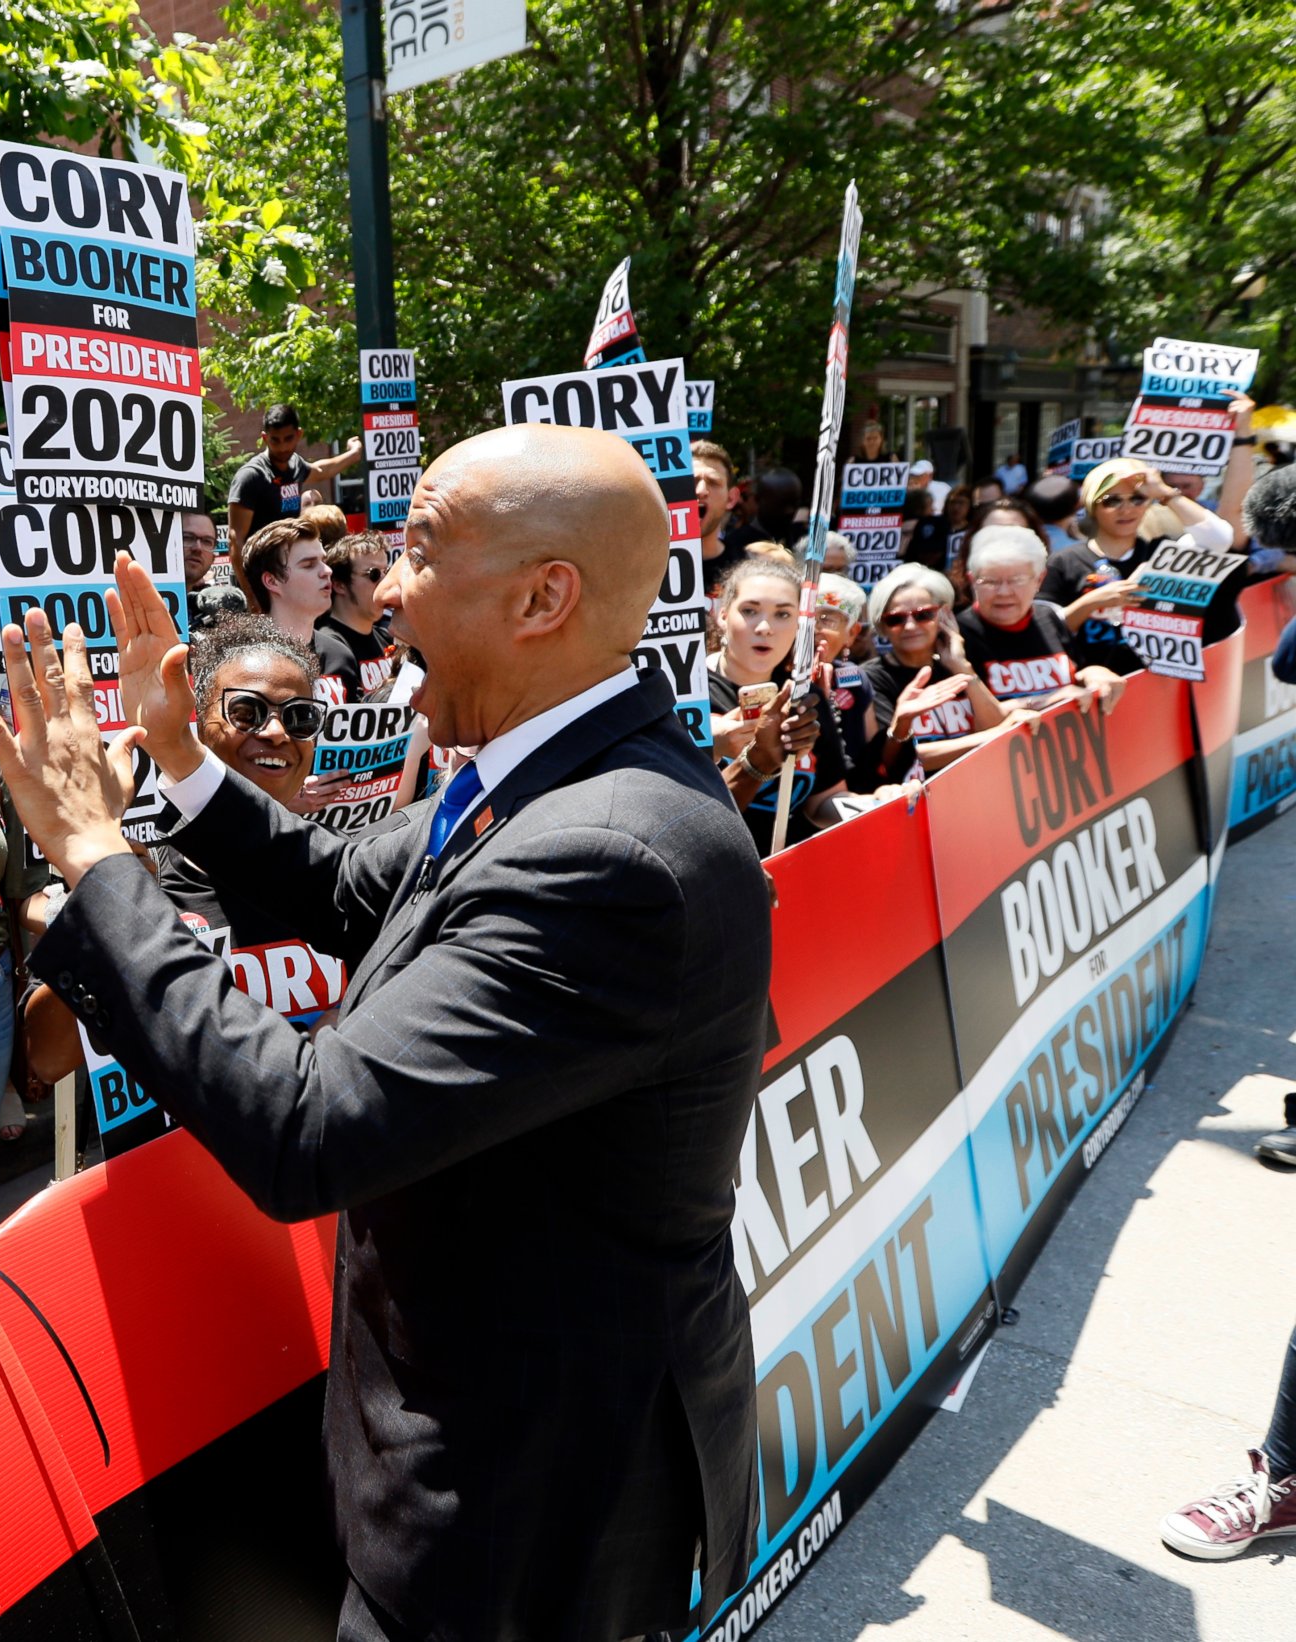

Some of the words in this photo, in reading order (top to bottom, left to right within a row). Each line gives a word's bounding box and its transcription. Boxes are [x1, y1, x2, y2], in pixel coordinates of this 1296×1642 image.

[0, 151, 183, 245] CORY
[10, 235, 190, 308] BOOKER
[92, 303, 131, 330] FOR
[21, 331, 193, 387] PRESIDENT
[368, 354, 411, 379] CORY
[1151, 351, 1242, 377] CORY
[370, 382, 412, 400] BOOKER
[510, 366, 679, 430] CORY
[21, 384, 196, 472] 2020
[372, 413, 413, 428] PRESIDENT
[688, 412, 709, 429] ER
[373, 430, 415, 457] 2020
[632, 435, 688, 474] ER
[1076, 441, 1123, 460] COR
[1129, 429, 1226, 460] 2020
[24, 475, 198, 508] CORYBOOKER.COM
[376, 471, 418, 498] CORY
[848, 466, 908, 488] CORY
[378, 502, 412, 519] BOOK
[846, 490, 903, 504] BOOKER
[841, 515, 901, 529] PRESIDENT
[1151, 545, 1240, 579] CORY
[1125, 610, 1201, 635] PRESIDENT
[1127, 631, 1198, 667] 2020
[988, 654, 1071, 694] CORY
[323, 707, 416, 742] CORY
[319, 738, 408, 771] BOOKER
[354, 771, 374, 783] FOR
[1009, 706, 1114, 848] CORY
[1000, 797, 1166, 1007] BOOKER
[1089, 950, 1109, 981] FOR
[1005, 915, 1188, 1212] PRESIDENT
